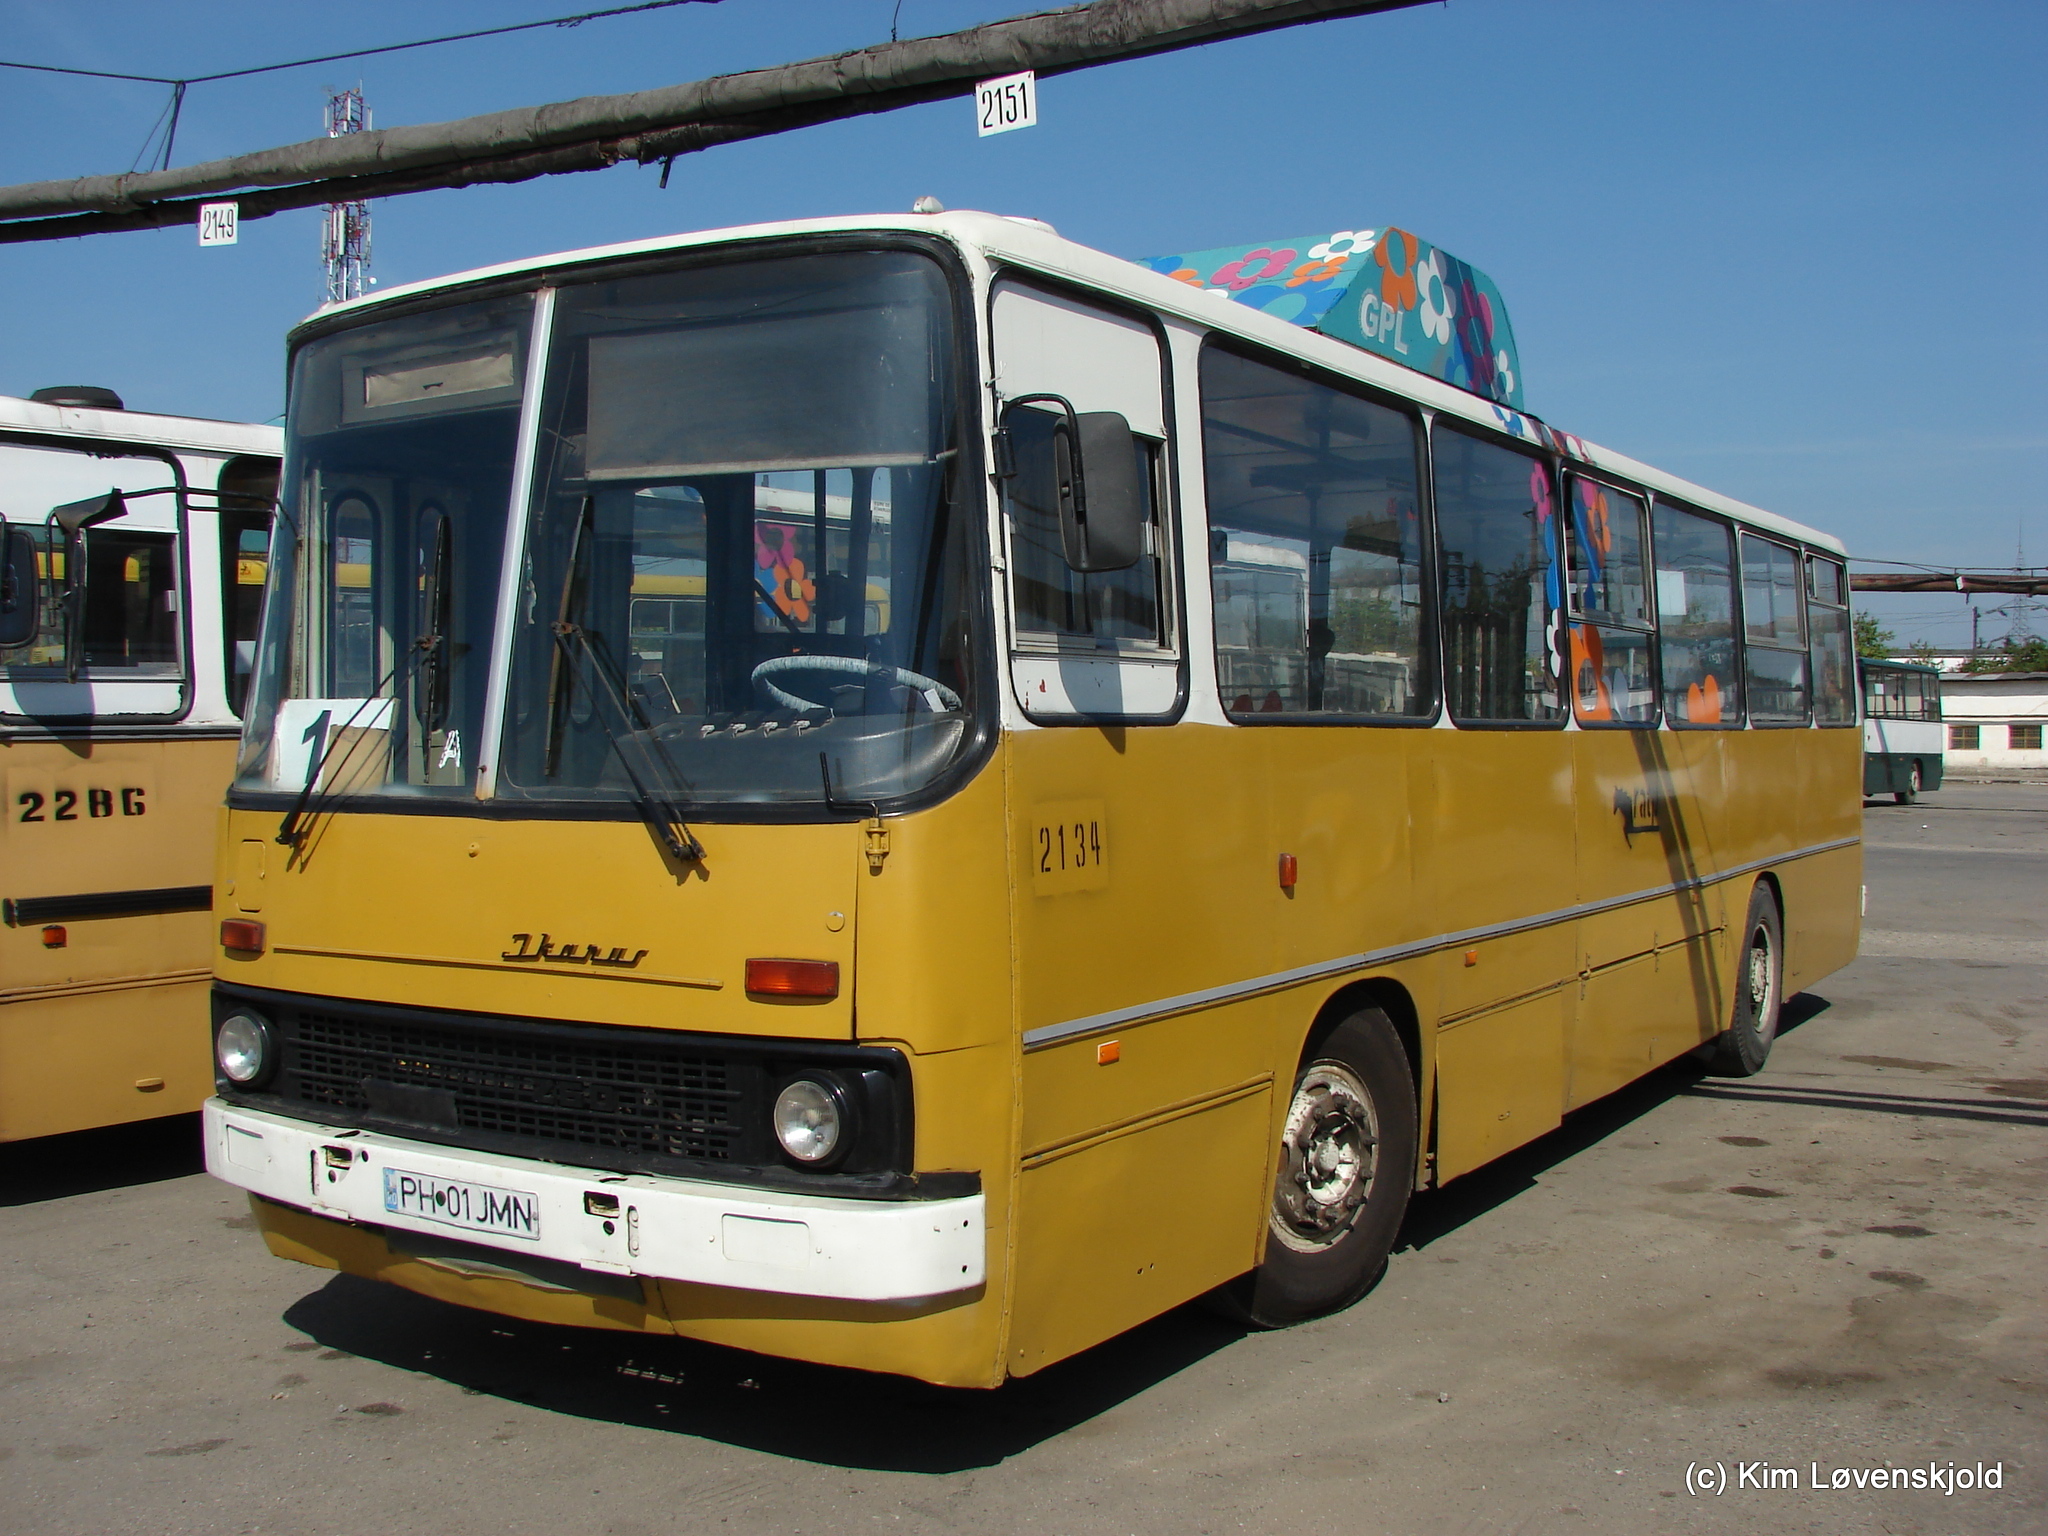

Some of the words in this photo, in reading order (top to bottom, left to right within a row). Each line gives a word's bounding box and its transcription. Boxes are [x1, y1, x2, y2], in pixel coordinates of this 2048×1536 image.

[982, 82, 1027, 128] 2151
[203, 209, 234, 240] 2149
[1359, 289, 1408, 355] GPL
[302, 710, 332, 786] 1
[438, 729, 461, 769] A
[19, 788, 146, 822] 2286
[1040, 821, 1100, 873] 2134
[501, 933, 649, 978] Ikarus
